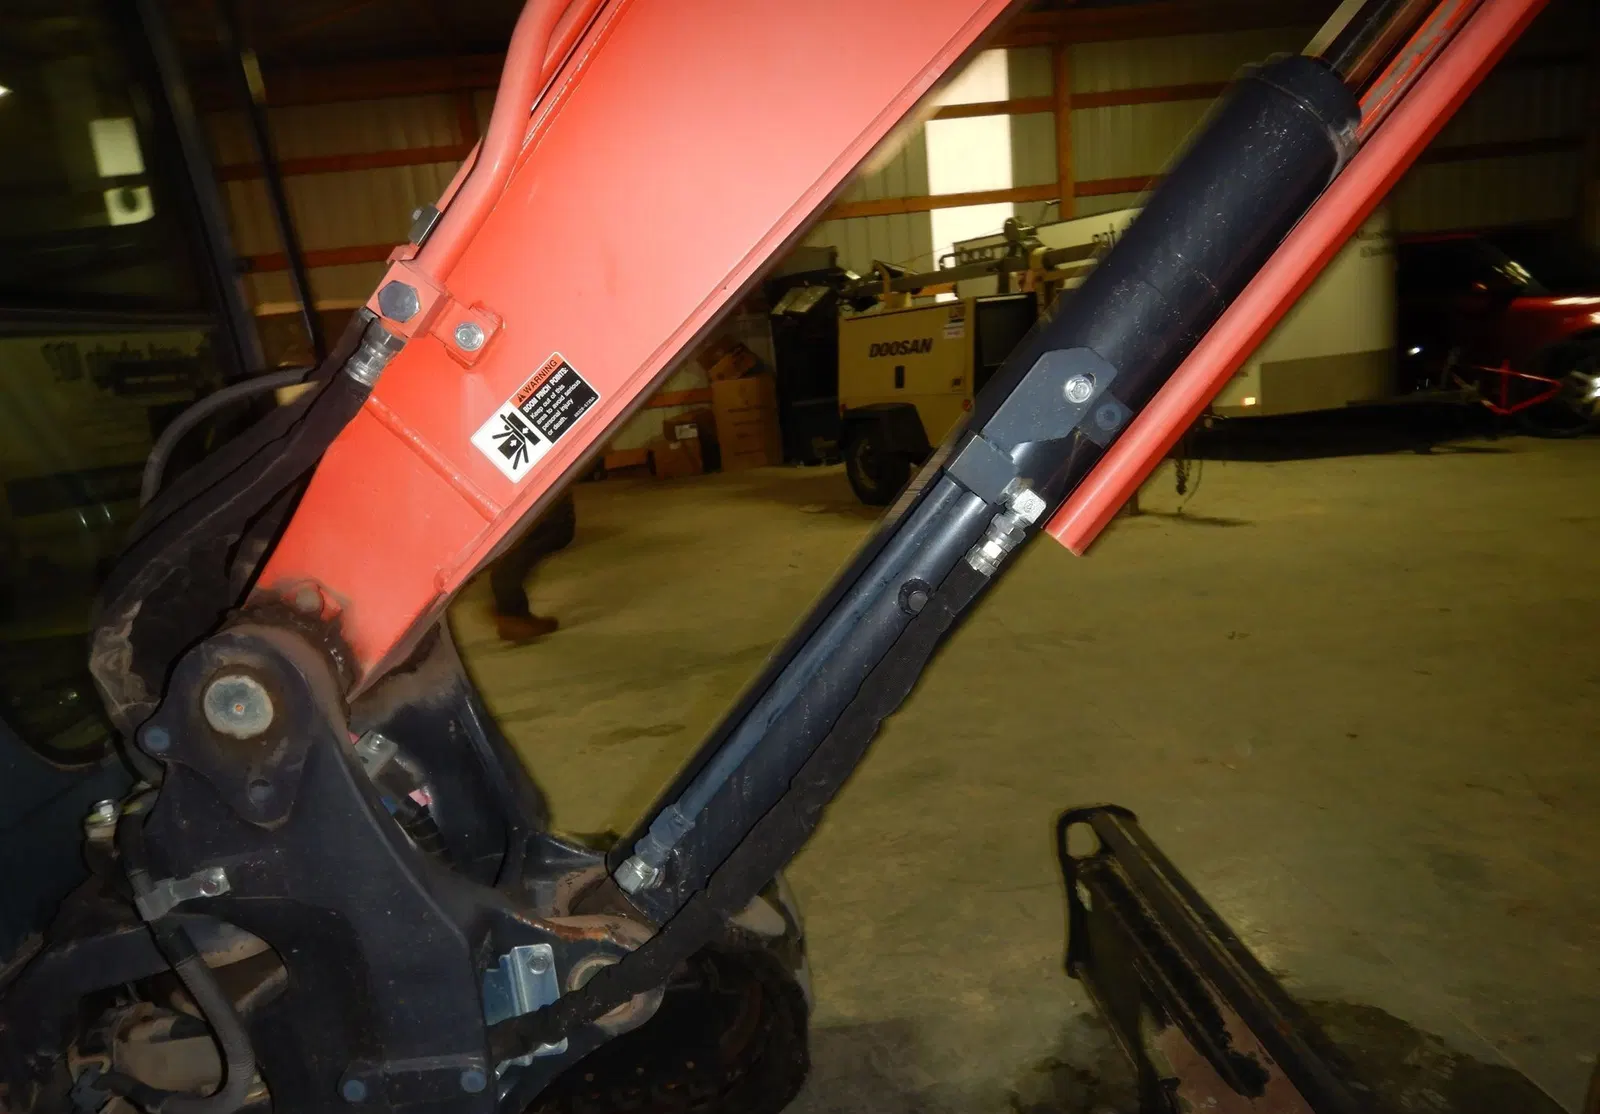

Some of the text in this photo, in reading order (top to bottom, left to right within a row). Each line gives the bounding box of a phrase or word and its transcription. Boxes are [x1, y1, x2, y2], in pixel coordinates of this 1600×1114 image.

[869, 338, 933, 358] DOOSAN
[522, 367, 568, 412] BOOM PINCH POINTS:
[523, 359, 558, 394] WARNING
[530, 406, 543, 419] Keep
[543, 399, 551, 407] out
[556, 384, 565, 394] this
[537, 413, 548, 424] area
[552, 396, 565, 410] avoid
[564, 380, 581, 396] serious
[542, 410, 561, 431] personal
[560, 398, 574, 412] injury
